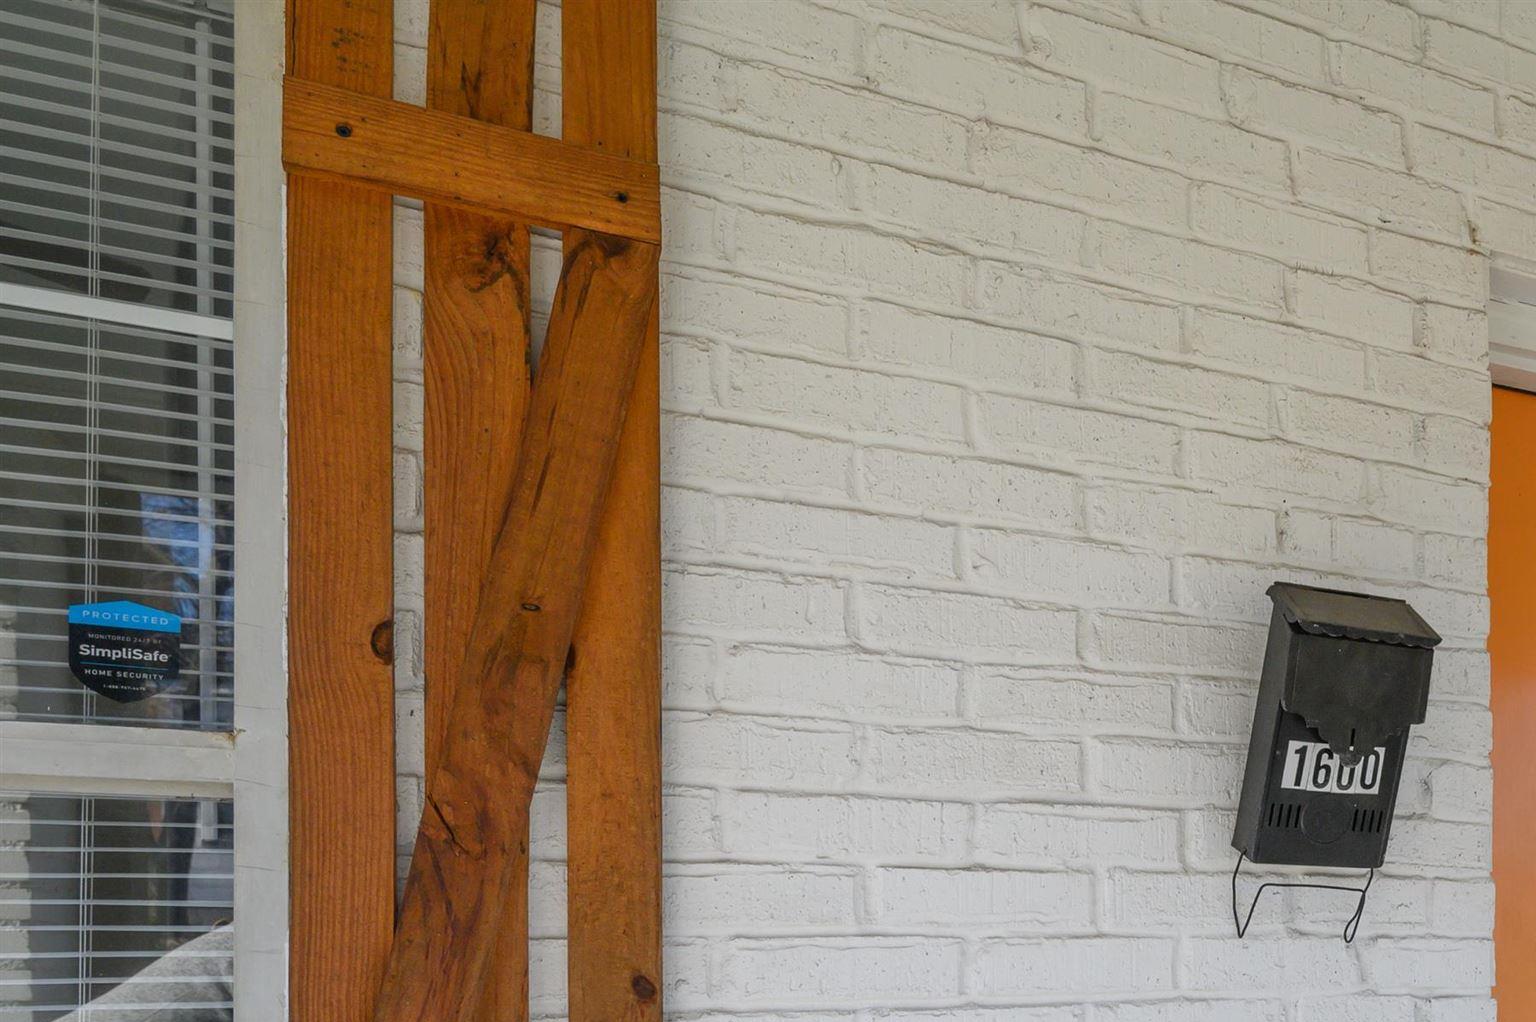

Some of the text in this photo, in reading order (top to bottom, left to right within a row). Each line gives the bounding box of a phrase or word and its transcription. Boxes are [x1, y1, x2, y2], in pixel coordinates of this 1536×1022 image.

[82, 610, 169, 626] PROTECTED
[88, 633, 131, 643] MONITORED
[79, 644, 168, 662] SimpliSafe
[84, 668, 164, 680] HOME SECURITY
